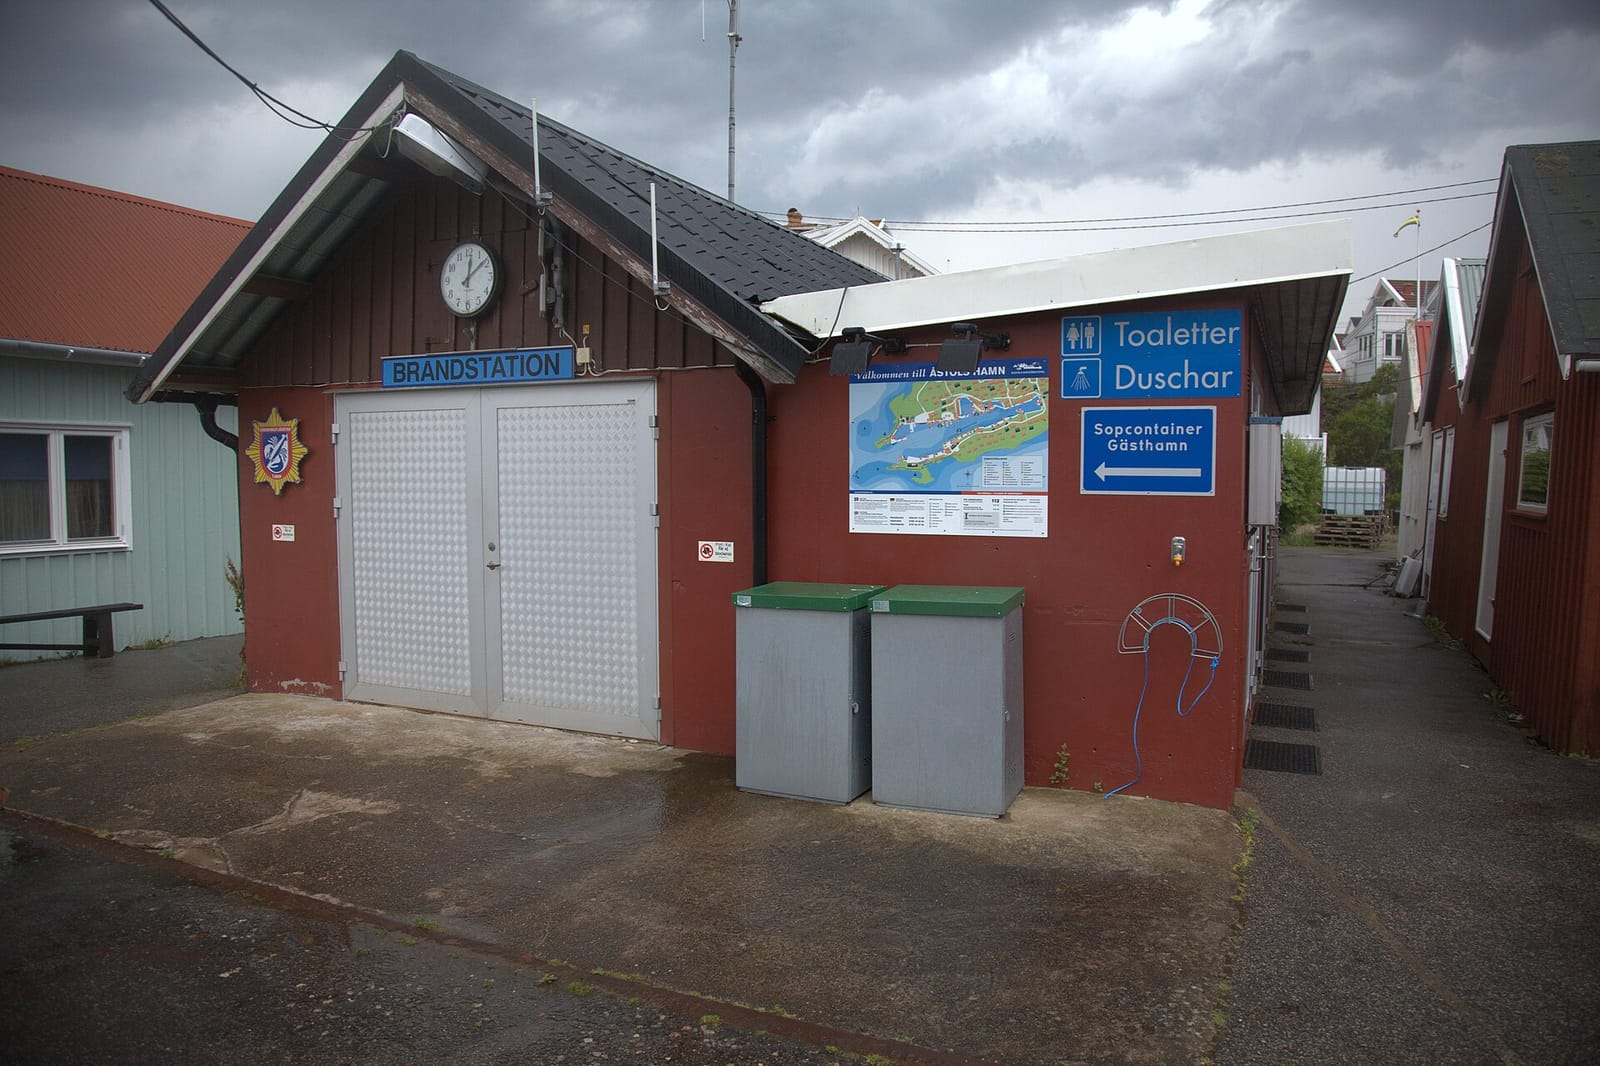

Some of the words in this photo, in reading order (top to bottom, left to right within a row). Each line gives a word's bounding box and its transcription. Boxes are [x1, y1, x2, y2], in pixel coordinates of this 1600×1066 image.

[1114, 316, 1240, 347] Toaletter
[393, 353, 560, 383] BRANDSTATION
[911, 368, 926, 378] till
[973, 366, 1006, 376] HAMN
[1116, 359, 1233, 390] Duschar
[1094, 423, 1203, 437] Sopcontainer
[1108, 439, 1188, 451] Gästhamn
